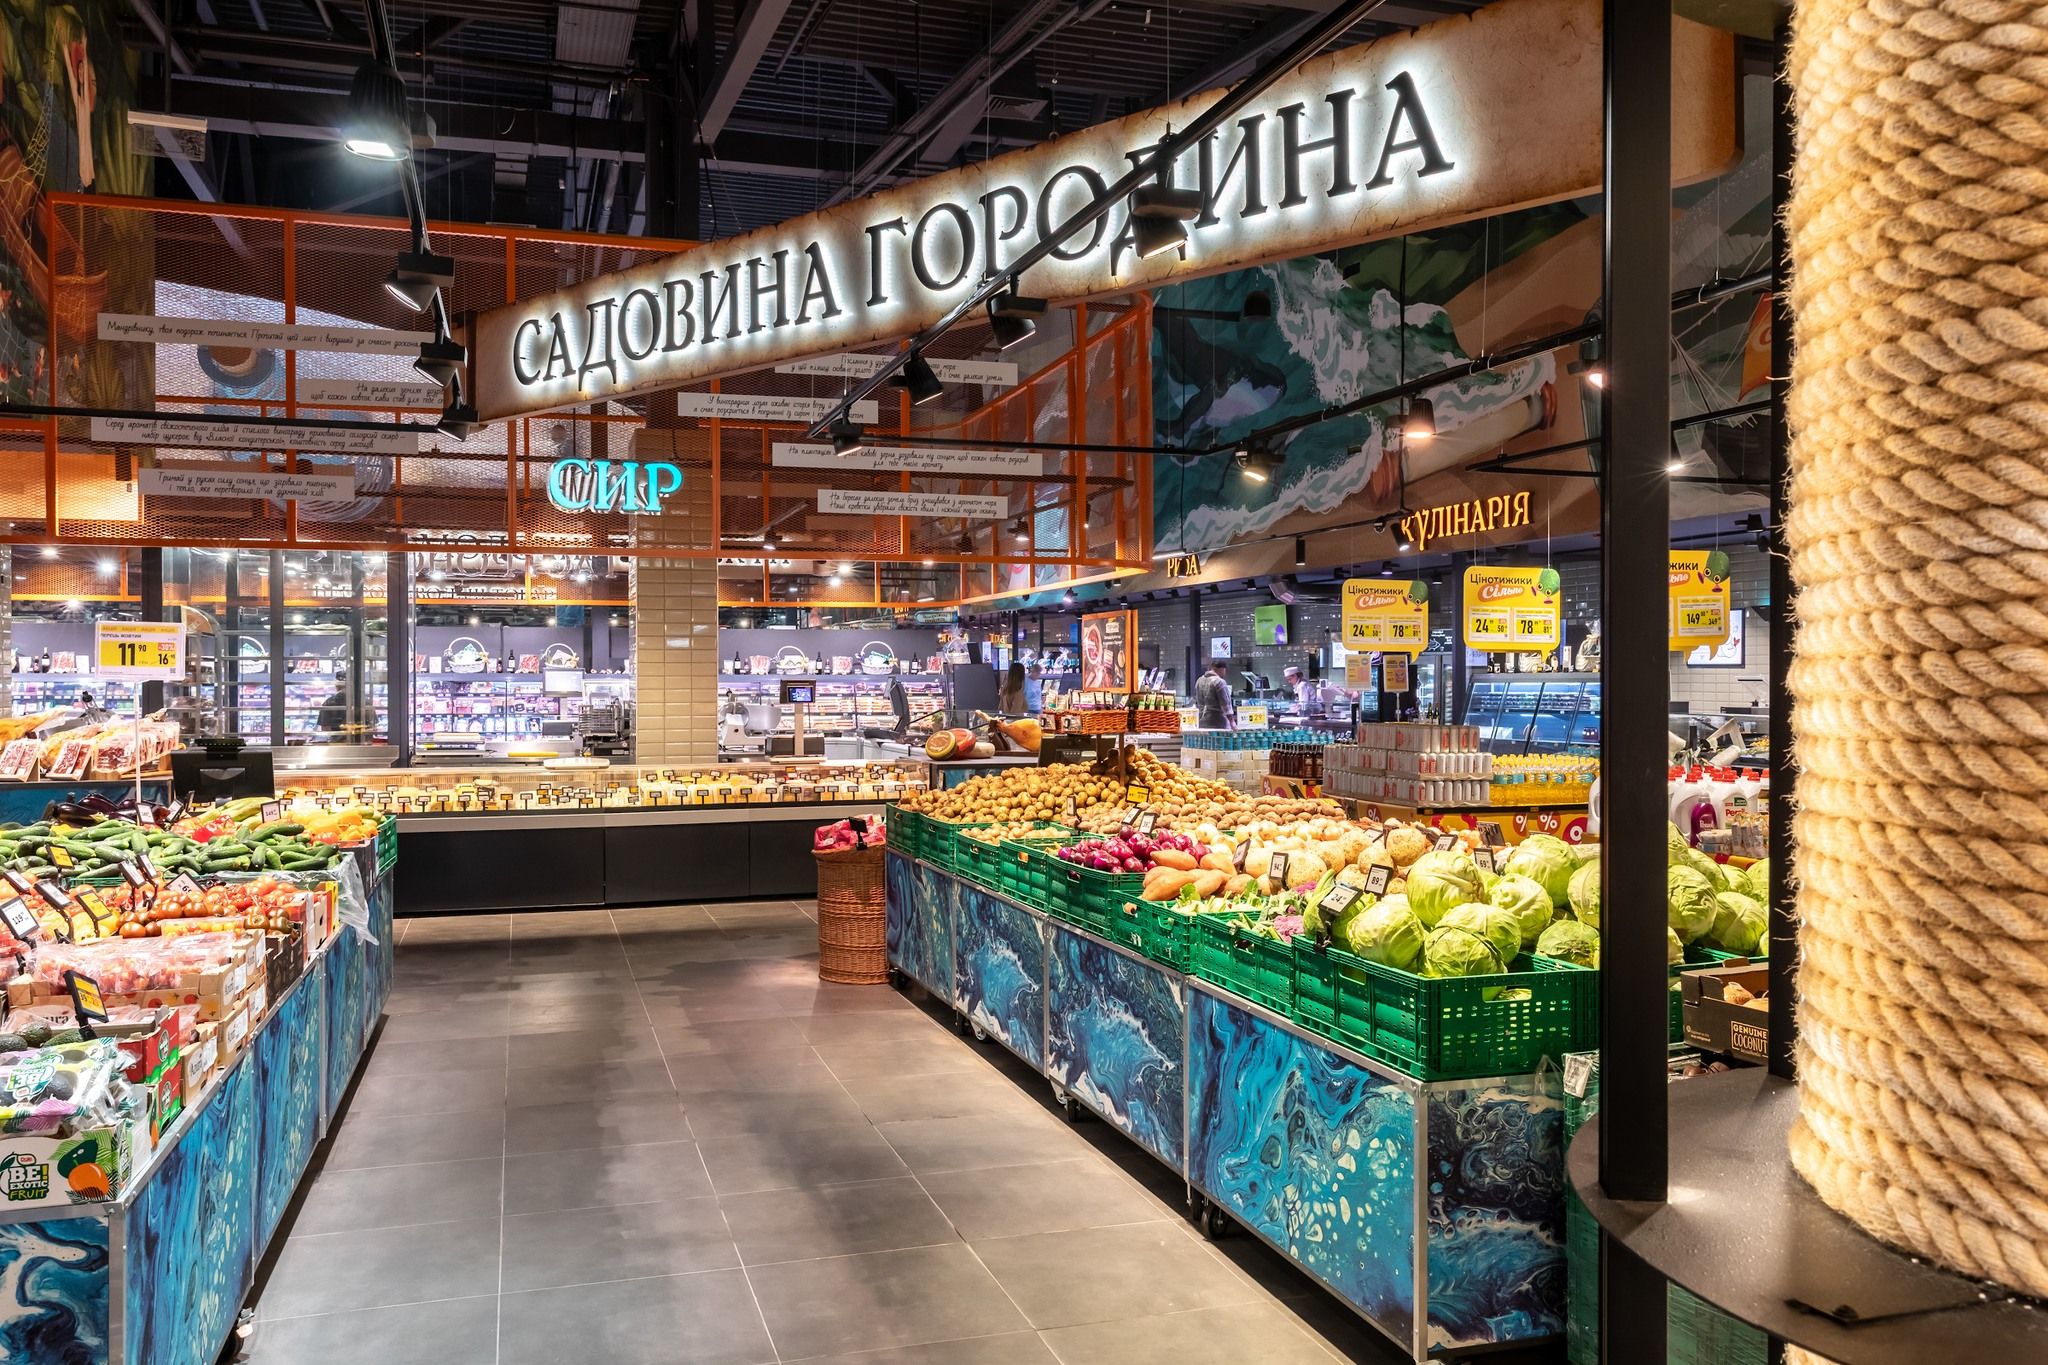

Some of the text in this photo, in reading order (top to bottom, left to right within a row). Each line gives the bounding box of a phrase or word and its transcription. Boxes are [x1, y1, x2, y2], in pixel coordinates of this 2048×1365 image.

[511, 241, 843, 392] САДОВИНА
[548, 457, 684, 514] СИР
[1400, 491, 1531, 551] КУЛІНАРІЯ
[1470, 573, 1533, 585] Цінотижики
[1348, 585, 1404, 595] Цінотижики
[1482, 584, 1523, 599] Сільпо
[1358, 594, 1396, 608] Сільпо
[1475, 618, 1489, 633] 24
[1687, 613, 1700, 625] 149
[1353, 624, 1365, 637] 24
[1392, 624, 1405, 638] 78
[1521, 620, 1534, 634] 78
[118, 643, 147, 666] 11 90
[158, 653, 169, 665] 16
[1732, 1024, 1768, 1038] GENUINE
[1733, 1032, 1768, 1054] COCONUT
[10, 1164, 48, 1183] BE!
[10, 1181, 48, 1190] EXOTIC
[10, 1189, 47, 1200] FRUIT
